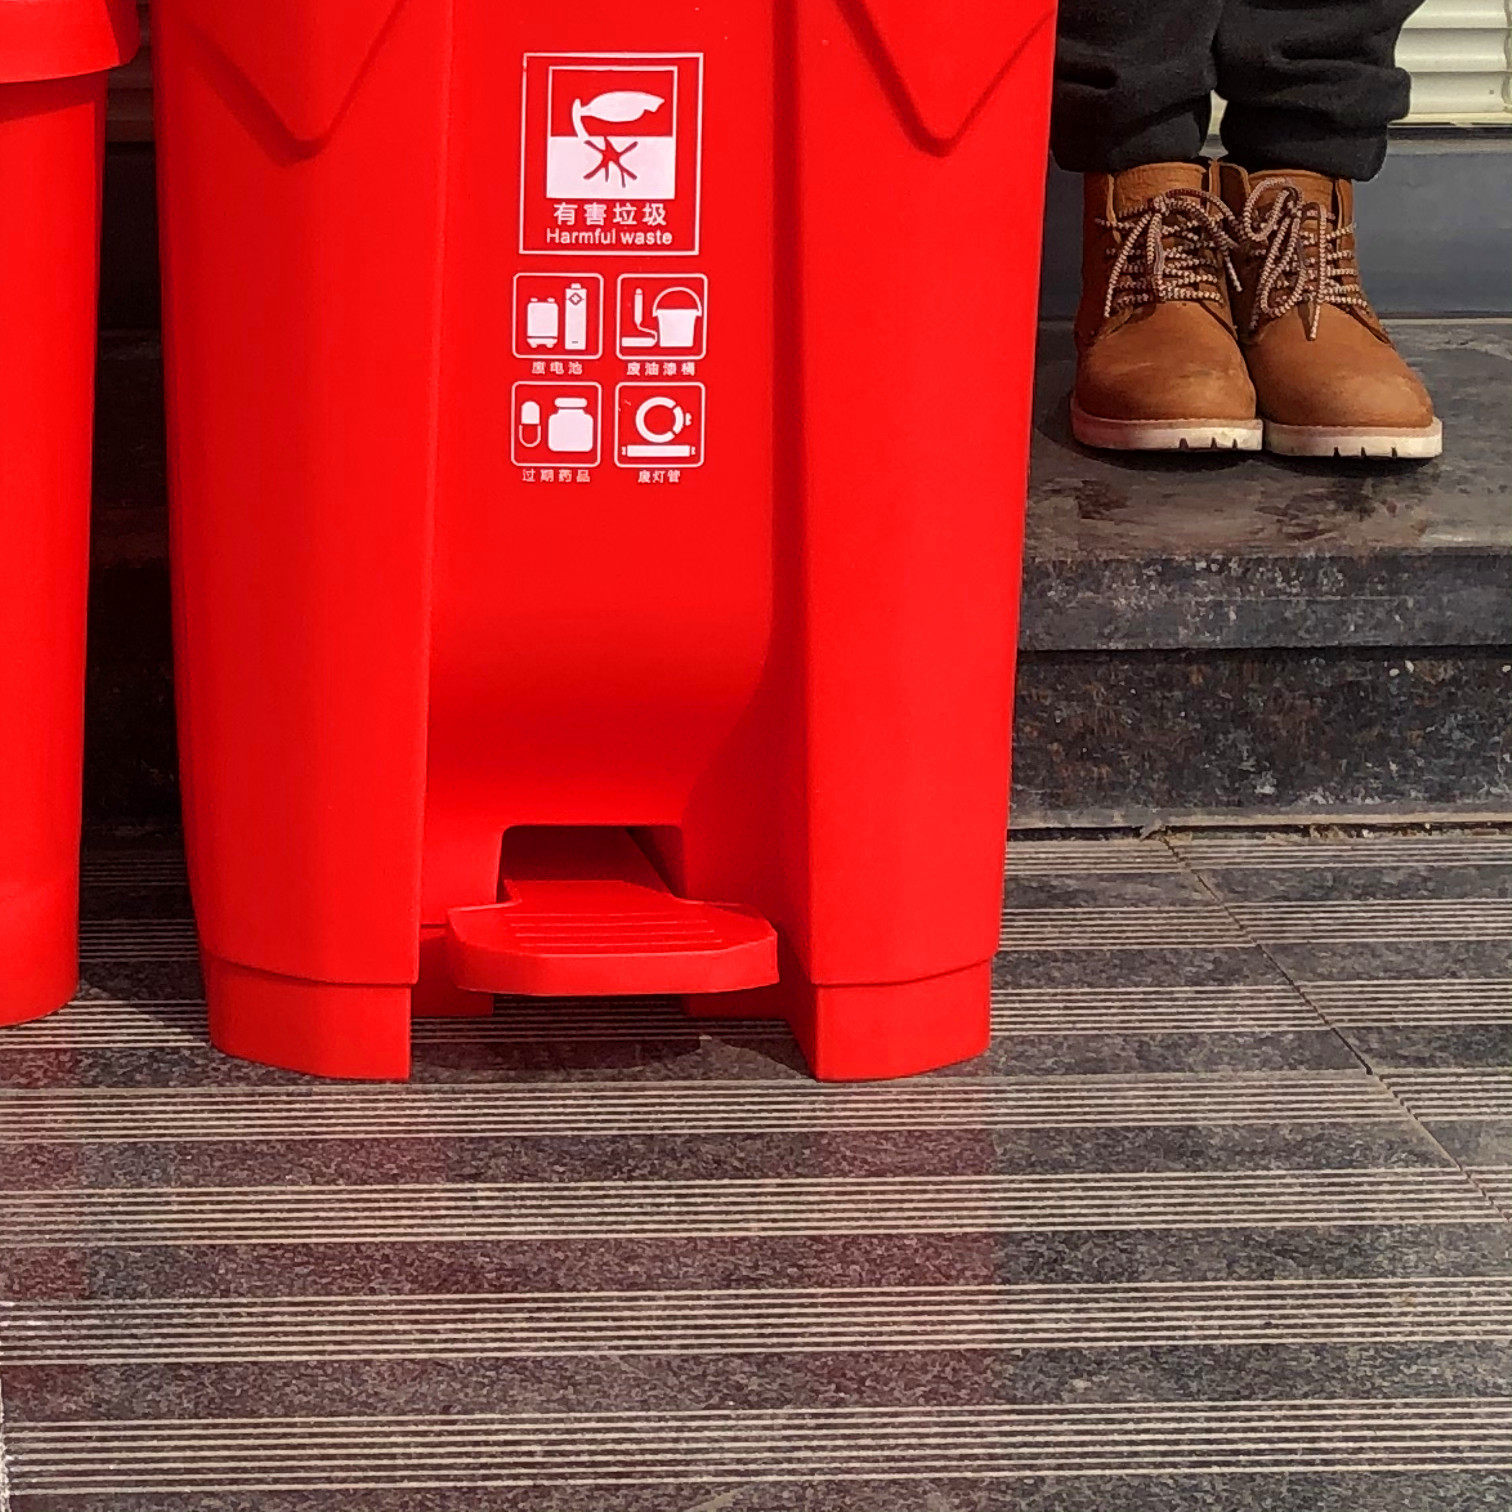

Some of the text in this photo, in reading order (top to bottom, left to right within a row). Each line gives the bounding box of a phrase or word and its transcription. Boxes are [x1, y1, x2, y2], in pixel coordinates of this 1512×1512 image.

[554, 202, 666, 226] 有害垃圾
[547, 228, 672, 244] Harmful waste
[532, 362, 582, 374] 废电池
[523, 469, 590, 482] 过期药品
[638, 470, 680, 483] 废灯管
